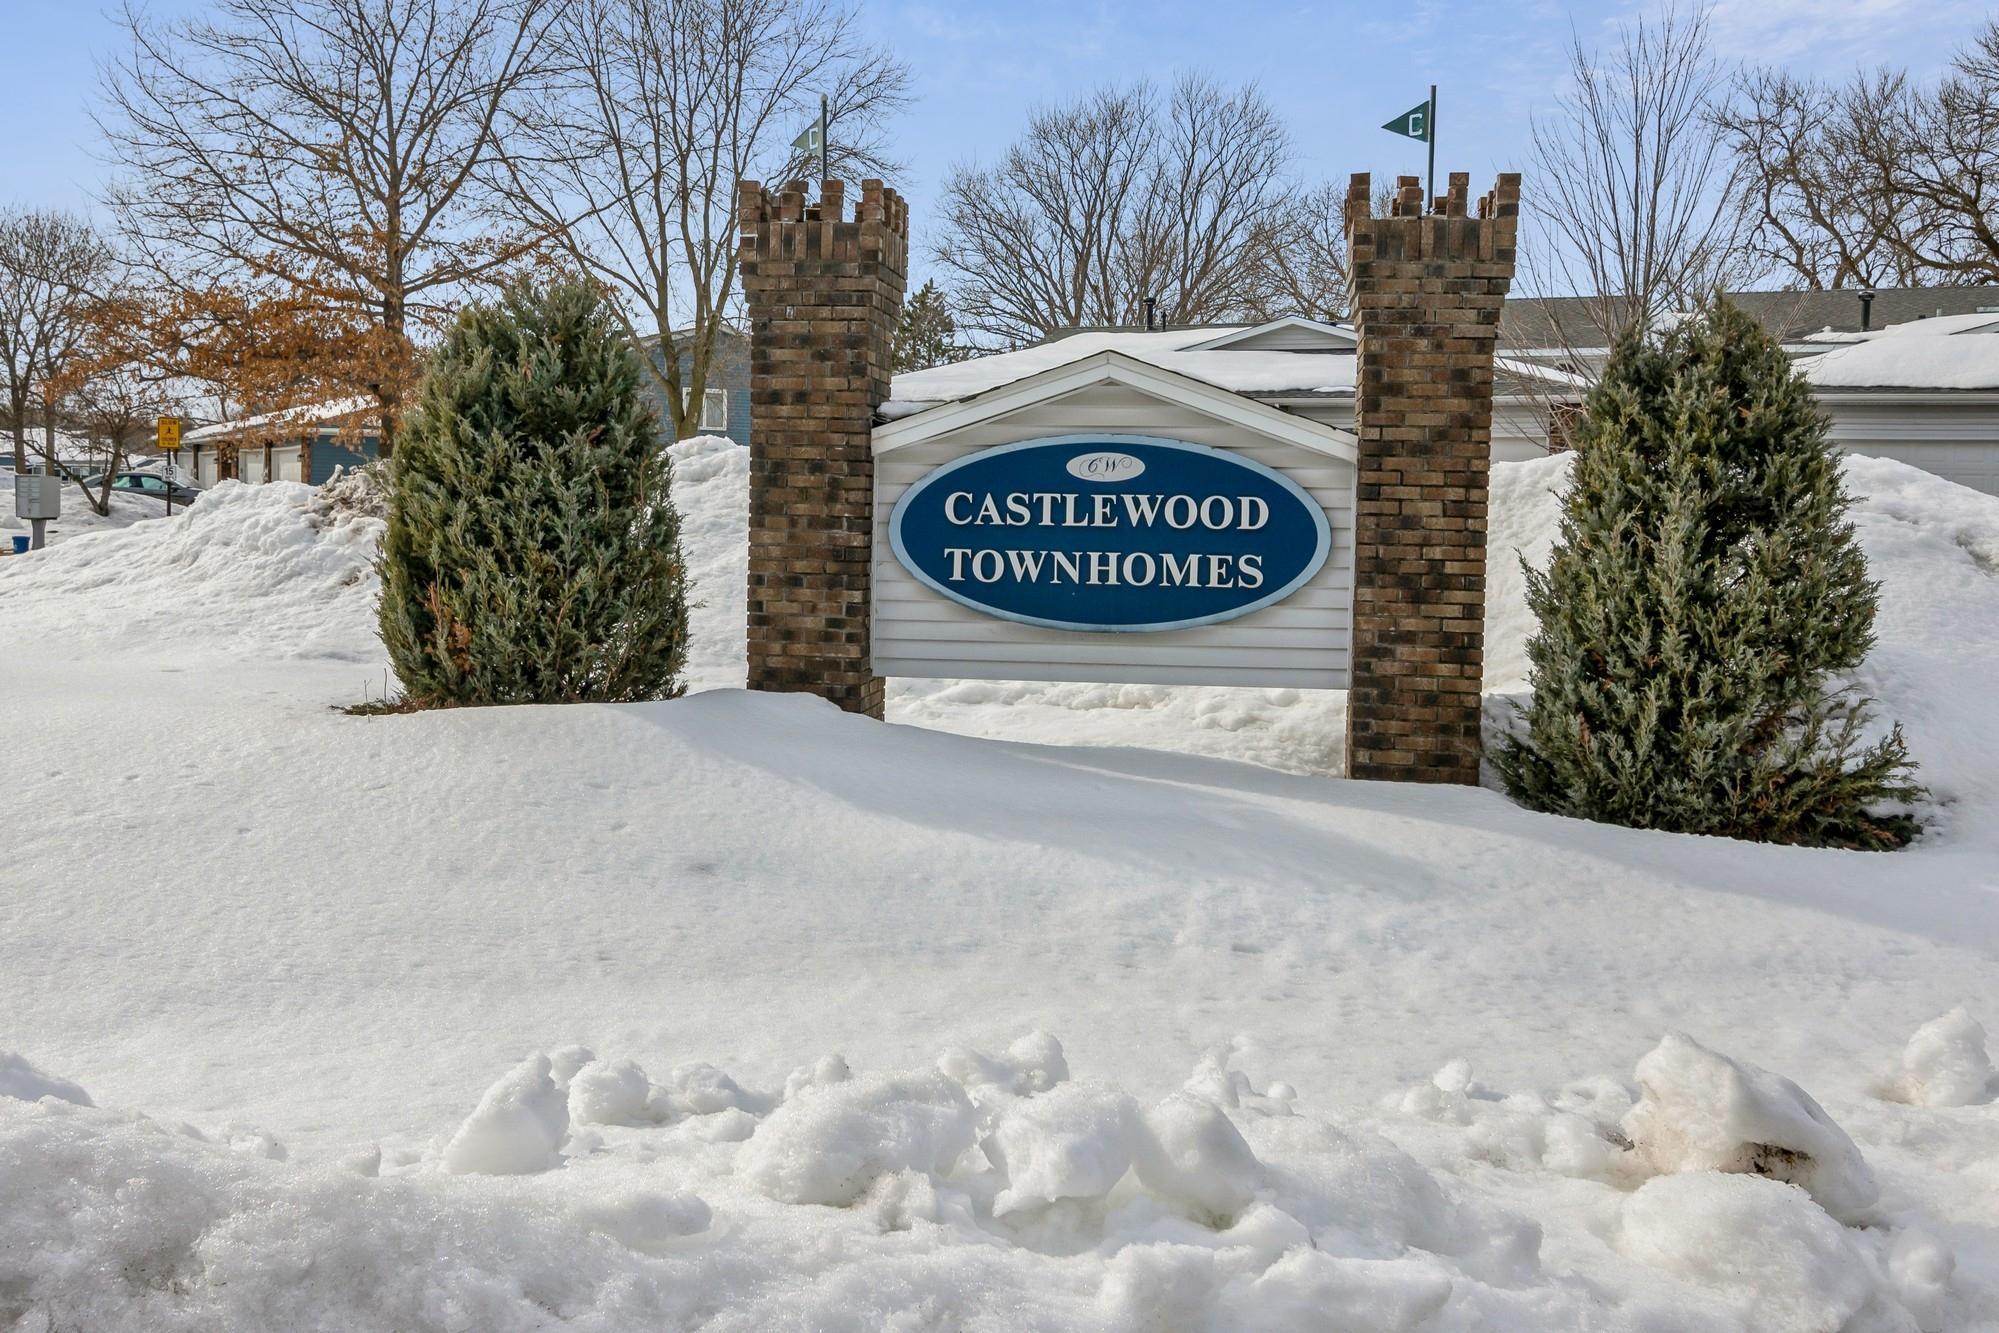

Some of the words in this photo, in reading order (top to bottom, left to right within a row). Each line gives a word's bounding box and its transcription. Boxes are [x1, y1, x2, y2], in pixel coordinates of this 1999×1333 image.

[1409, 113, 1423, 137] C
[809, 127, 819, 150] C
[165, 467, 174, 476] 15
[1079, 456, 1133, 479] CW
[944, 491, 1270, 530] CASTLEWOOD
[944, 548, 1265, 589] TOWNHOMES
